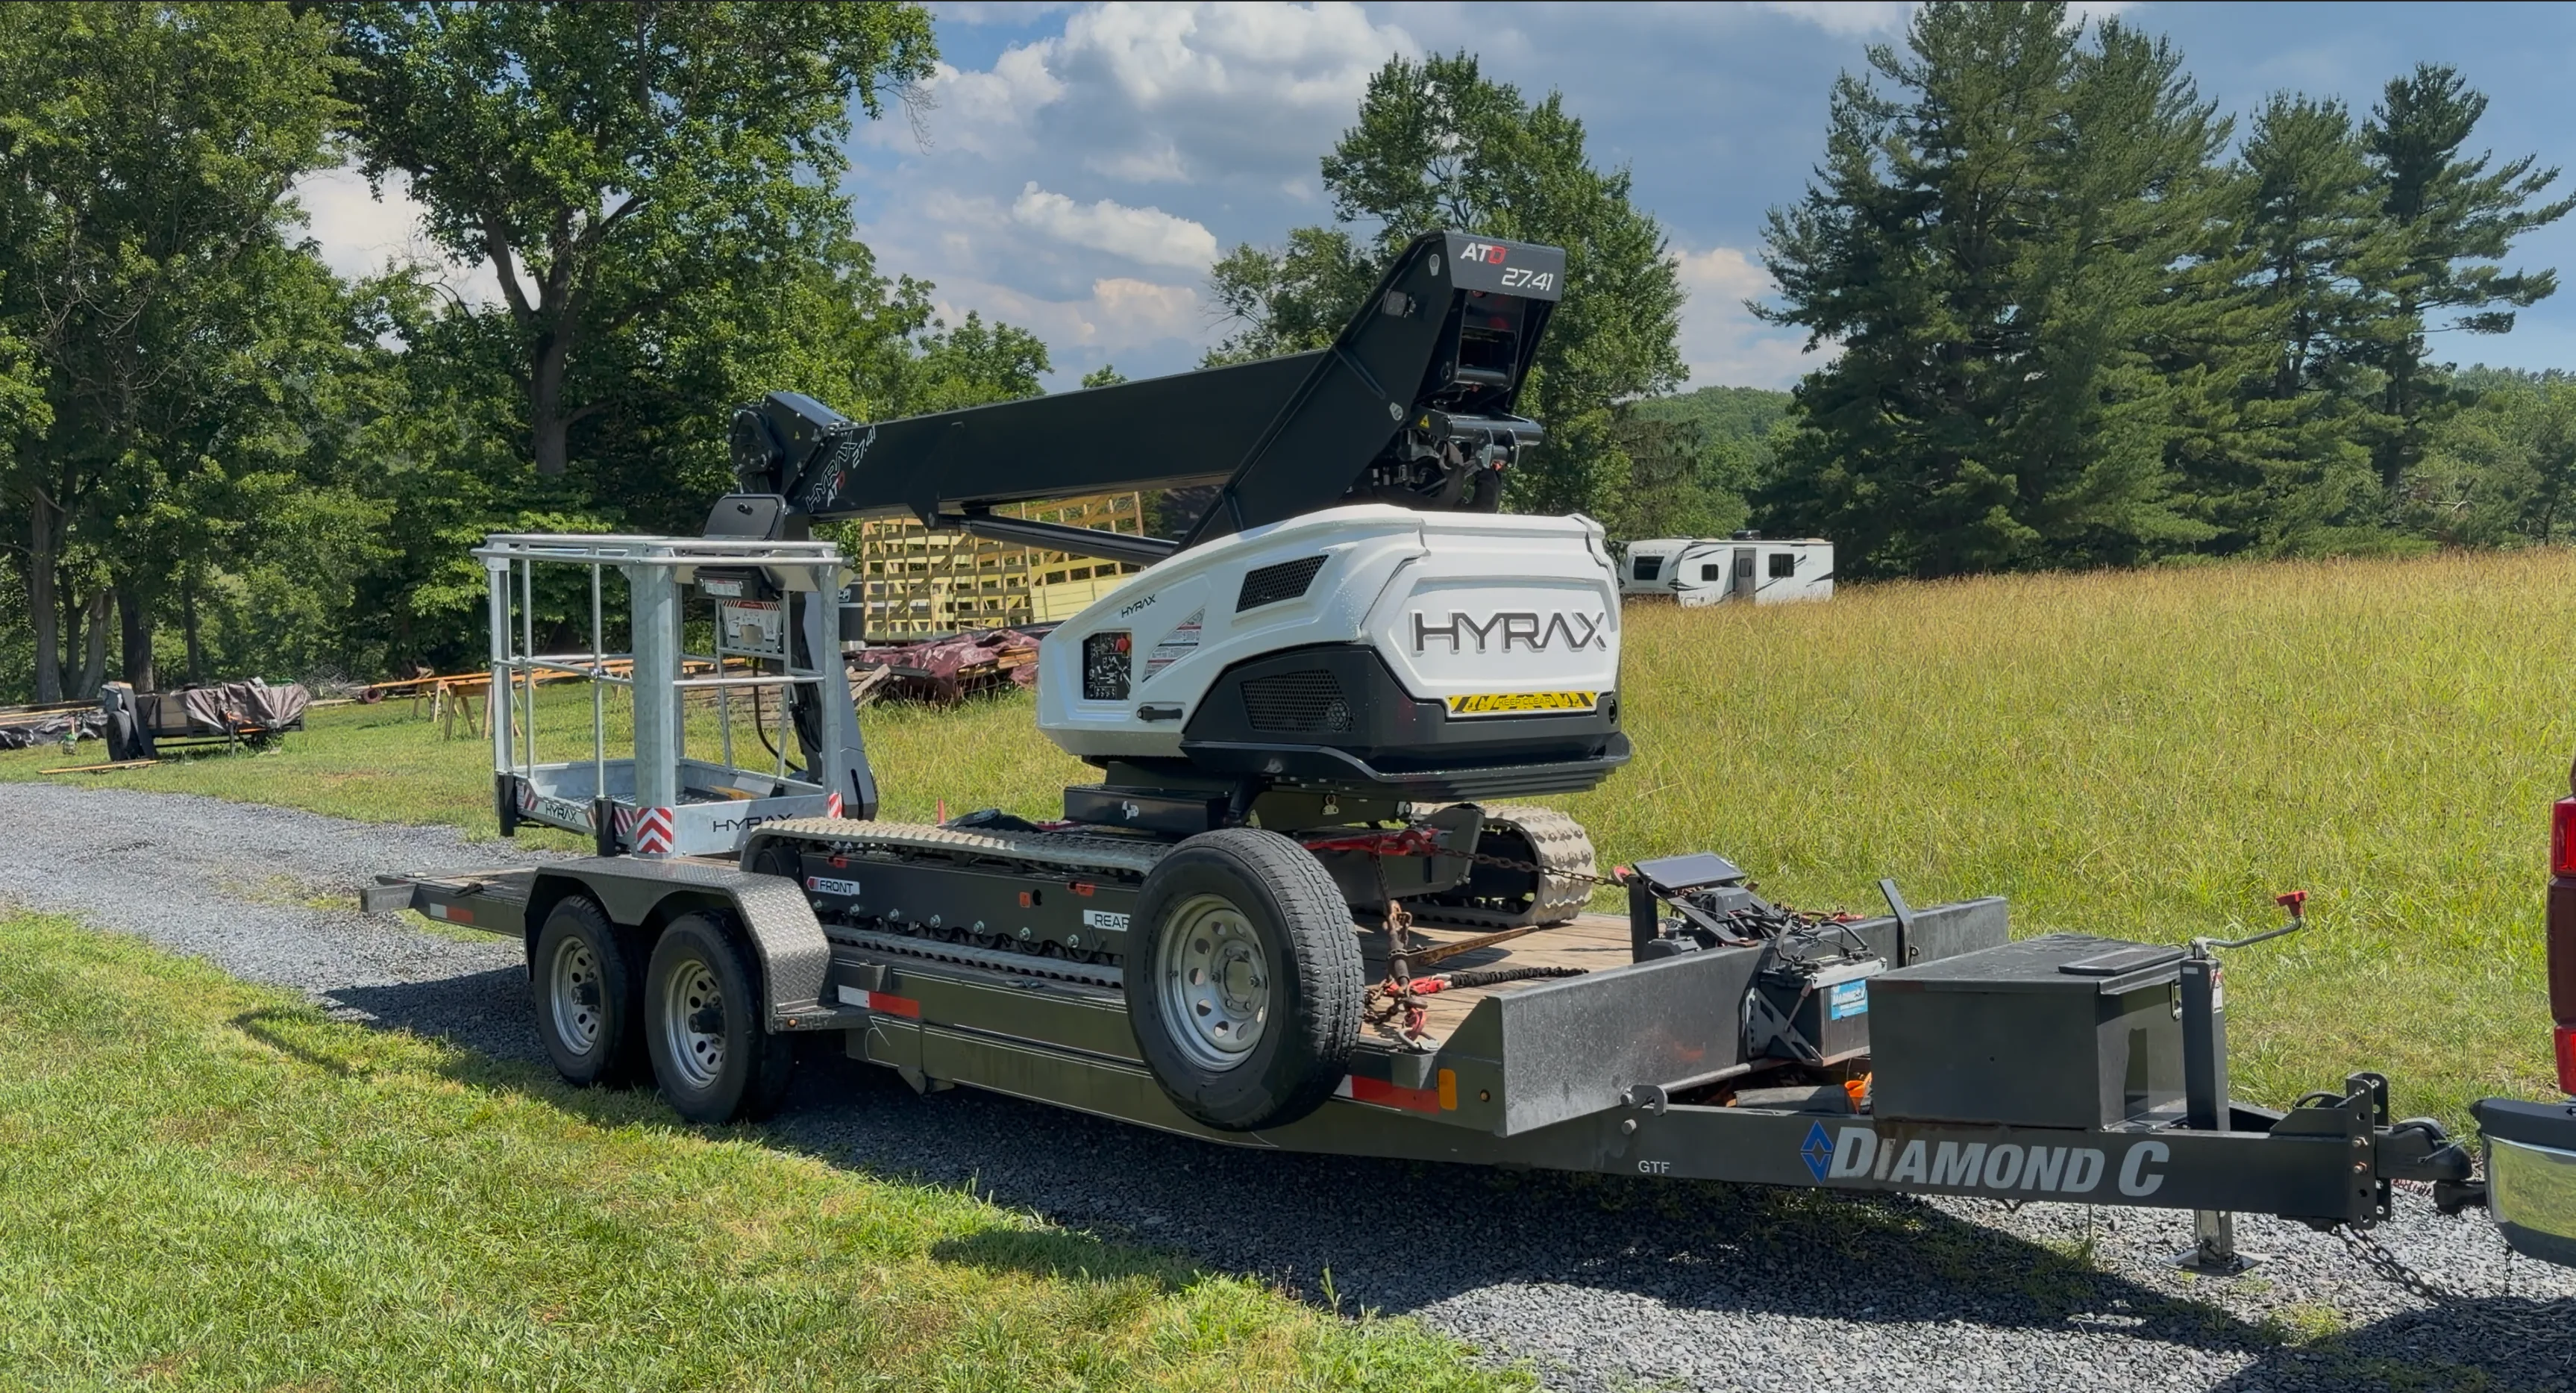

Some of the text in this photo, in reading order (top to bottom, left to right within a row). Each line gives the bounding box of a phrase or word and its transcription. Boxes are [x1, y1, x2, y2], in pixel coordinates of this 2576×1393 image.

[1501, 267, 1554, 291] 27.41
[852, 425, 876, 469] 27.41
[806, 430, 853, 513] HYRAX
[1121, 594, 1156, 618] HYRAX
[1410, 610, 1607, 656] HYRAX
[1498, 697, 1551, 707] KEEP CLEAR
[545, 803, 577, 824] HYRAX
[820, 880, 853, 893] FRONT
[1638, 1160, 1670, 1174] GTF
[2118, 1140, 2169, 1197] C
